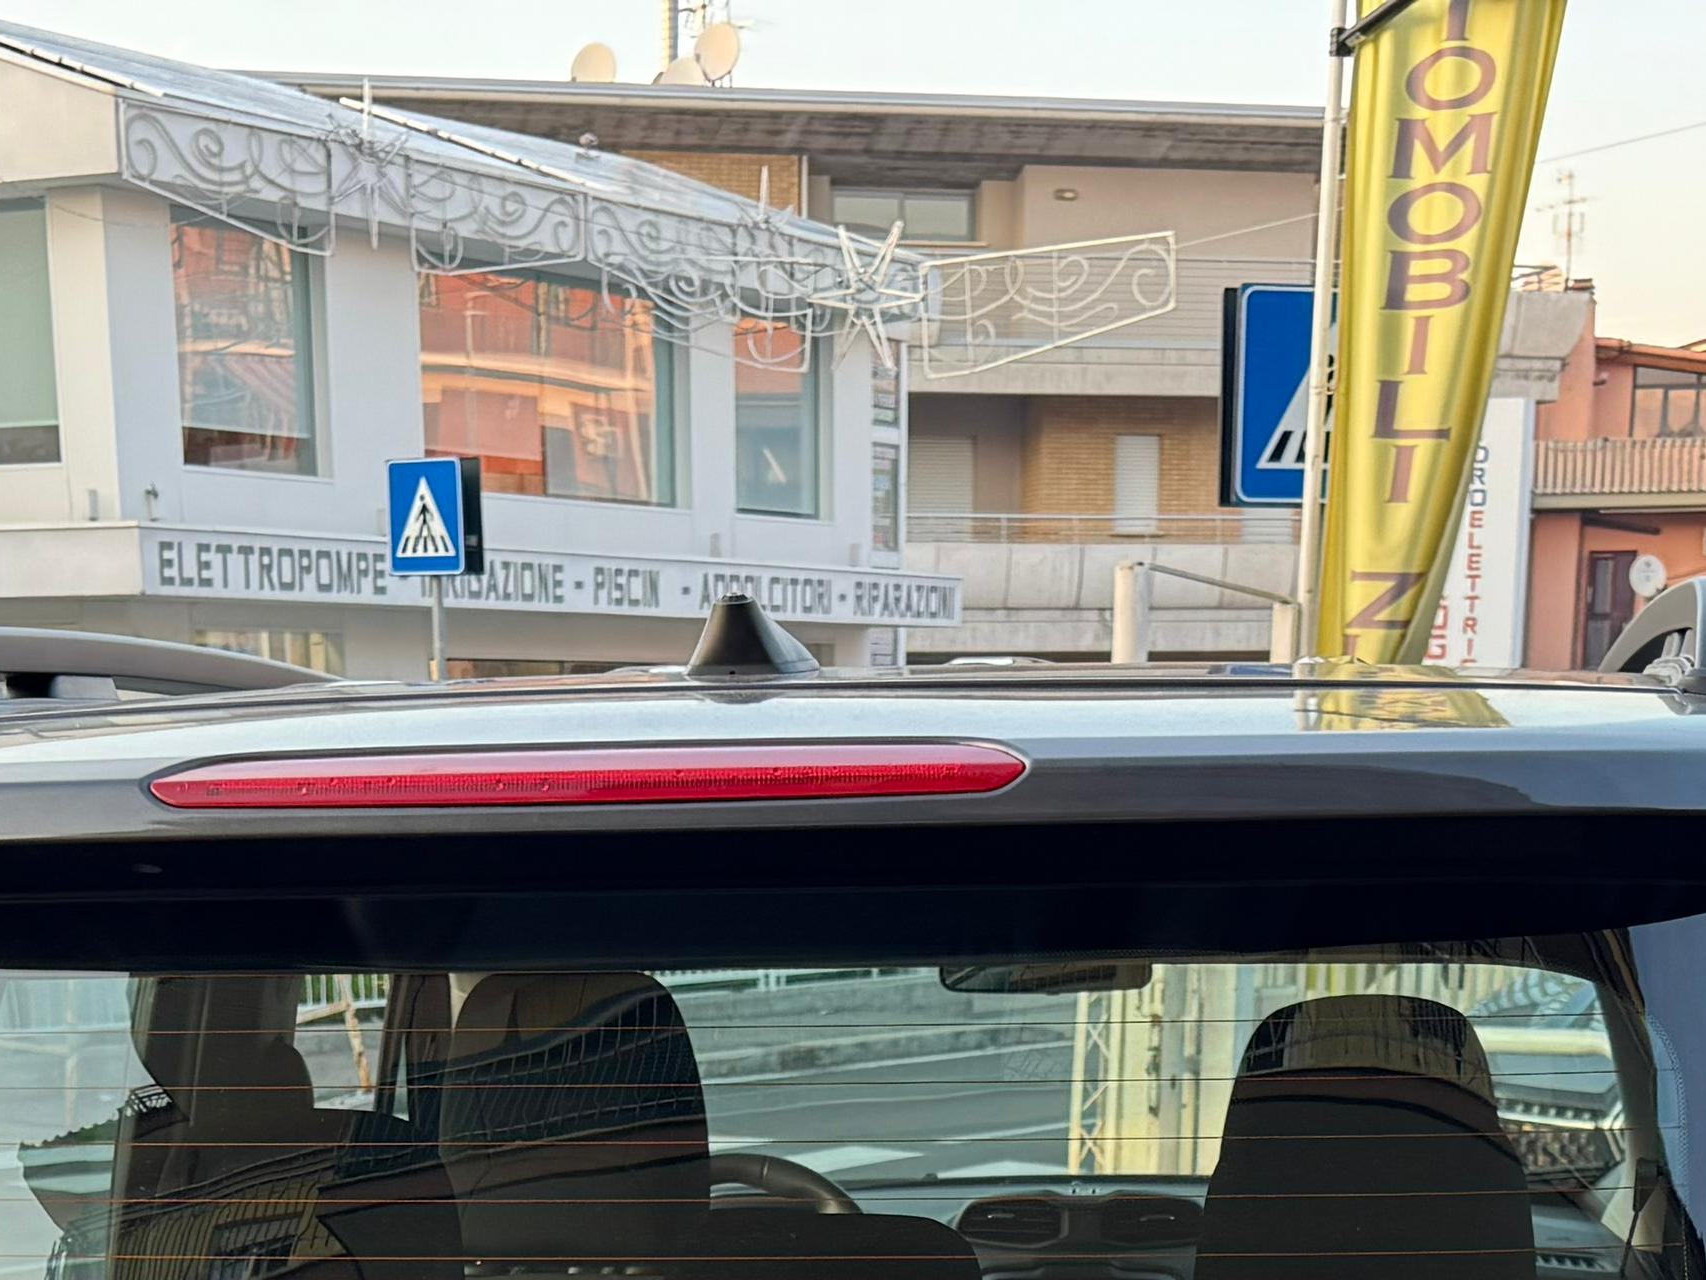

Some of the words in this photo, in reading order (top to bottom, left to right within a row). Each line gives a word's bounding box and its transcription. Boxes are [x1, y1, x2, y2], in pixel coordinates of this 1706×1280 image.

[158, 541, 388, 596] ELETTROPOMPE
[421, 559, 566, 604] IRIGAZIONE
[853, 581, 955, 620] RIPARAZIONI
